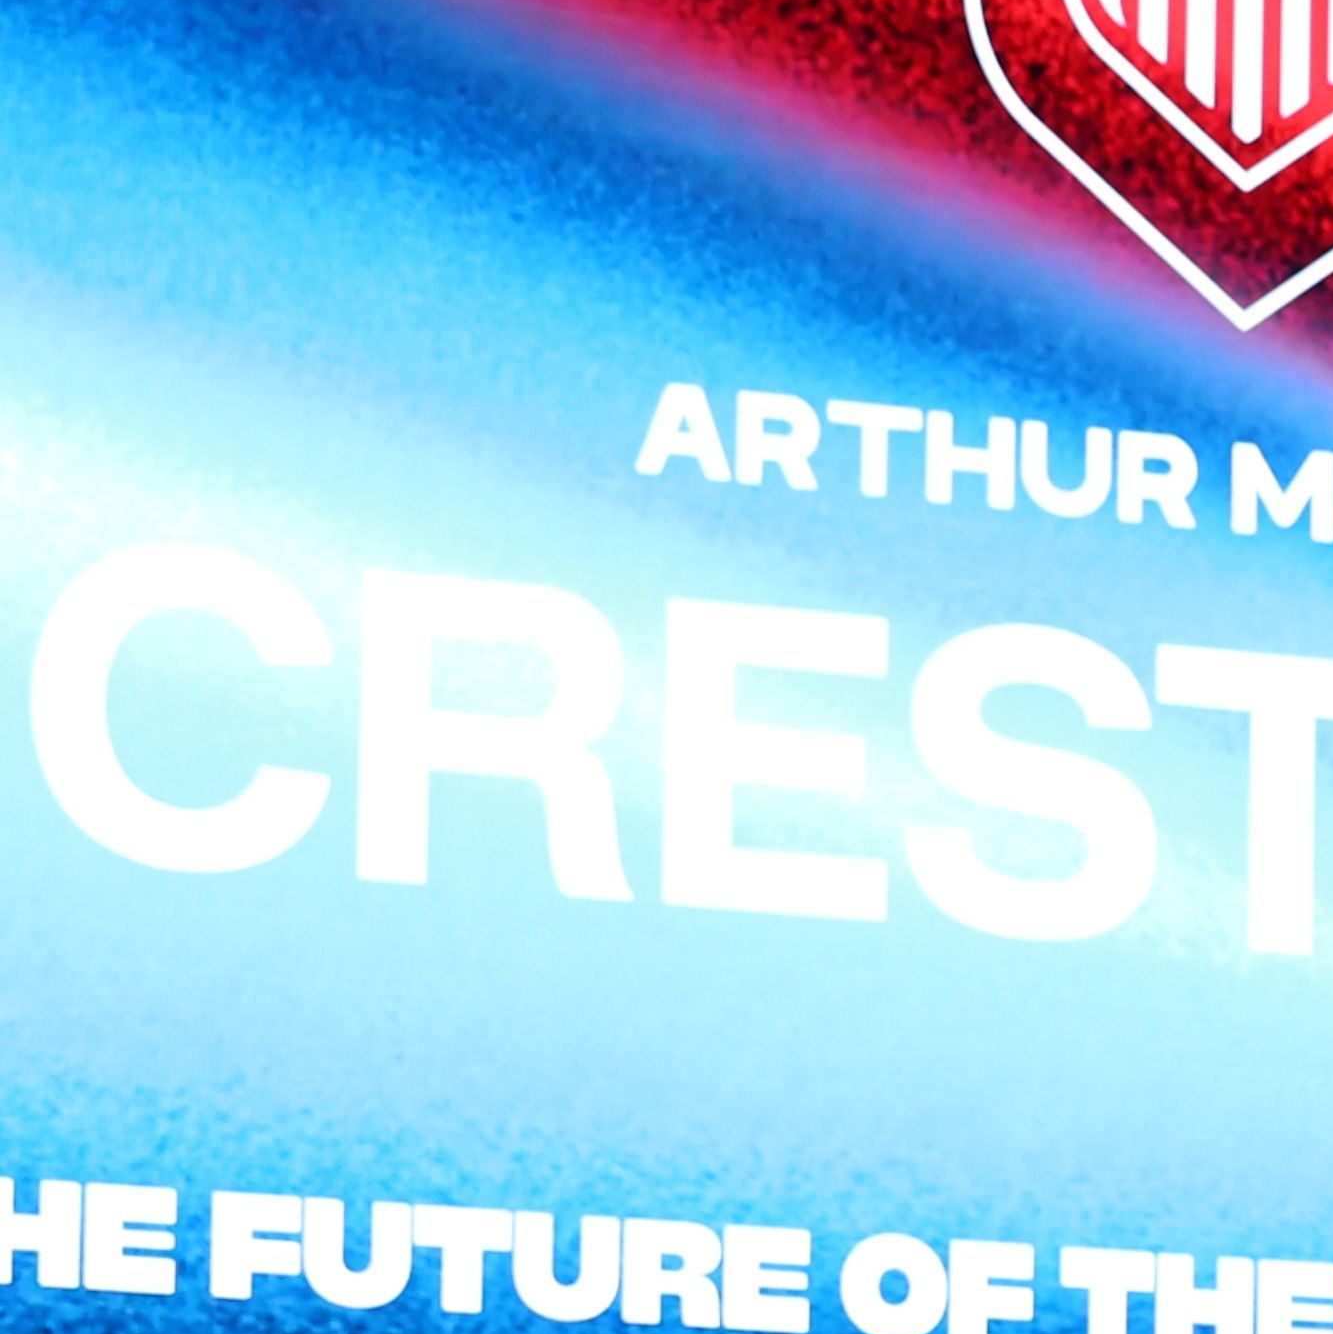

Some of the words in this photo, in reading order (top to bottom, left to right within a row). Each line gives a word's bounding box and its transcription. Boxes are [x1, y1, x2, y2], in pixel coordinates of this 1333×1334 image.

[636, 384, 1197, 528] ARTHUR
[0, 1178, 176, 1294] HE
[211, 1192, 810, 1333] FUTURE
